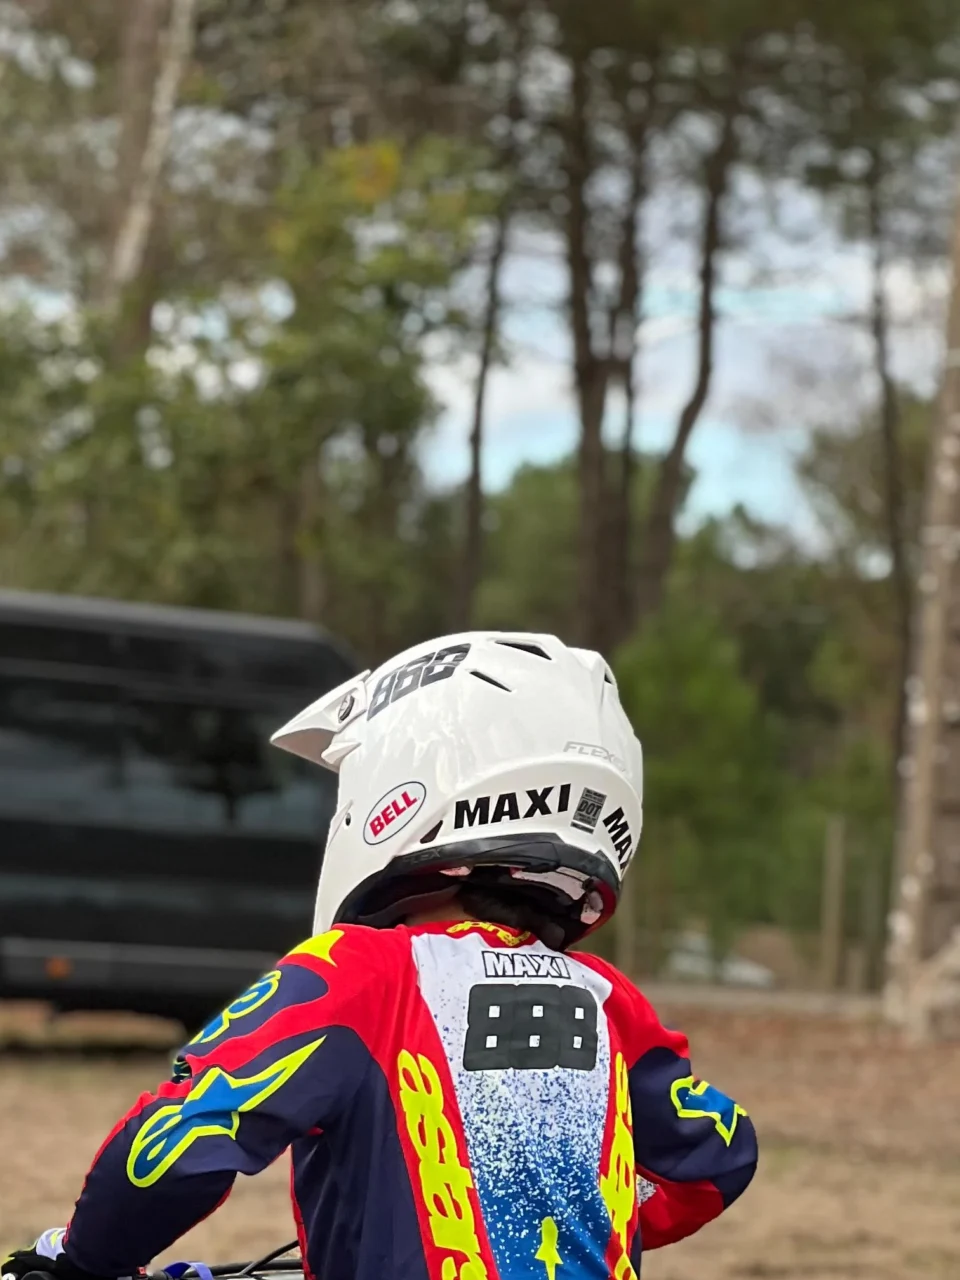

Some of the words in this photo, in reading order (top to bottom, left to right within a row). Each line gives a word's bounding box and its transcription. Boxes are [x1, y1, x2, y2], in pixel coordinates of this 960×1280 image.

[369, 791, 418, 837] BELL
[454, 783, 572, 829] MAXI
[577, 800, 602, 818] DOT
[482, 951, 571, 979] MAXI
